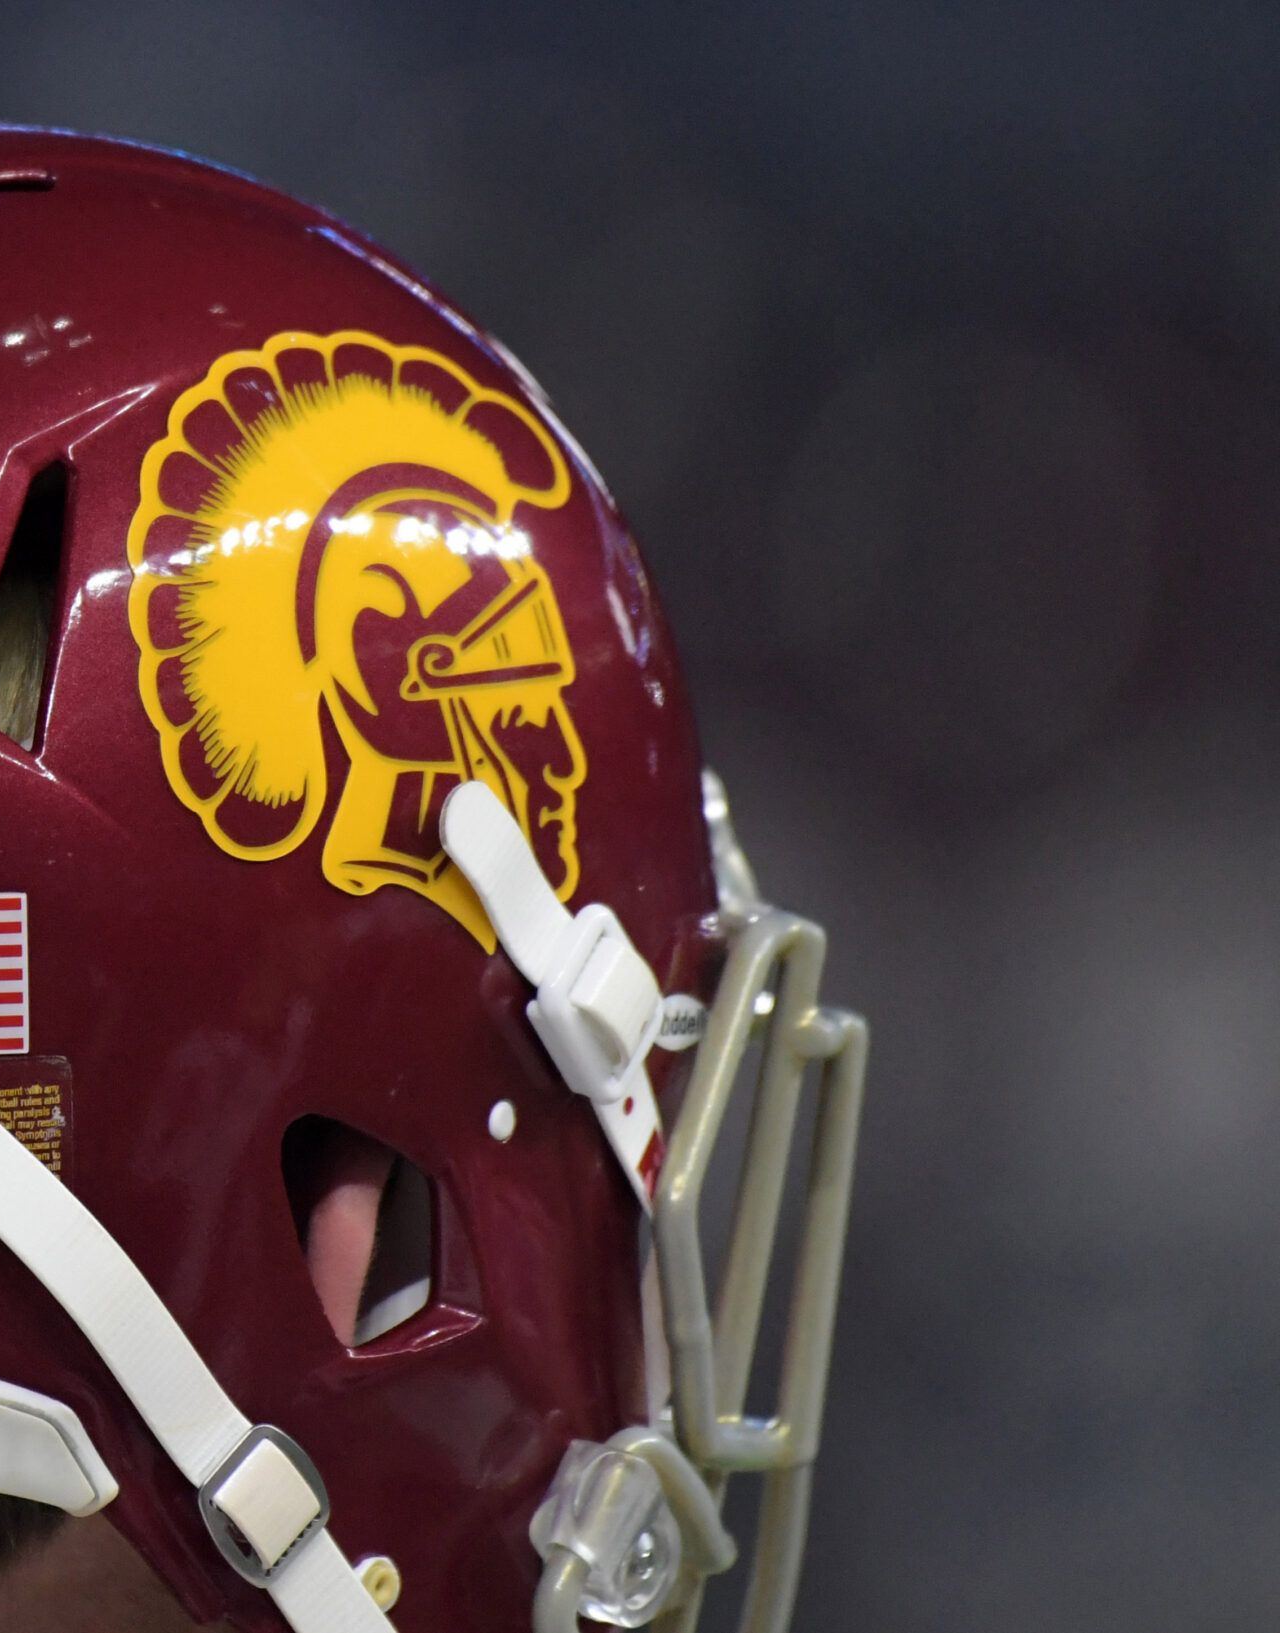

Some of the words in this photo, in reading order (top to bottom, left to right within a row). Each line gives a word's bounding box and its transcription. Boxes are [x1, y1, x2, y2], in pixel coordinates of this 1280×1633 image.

[44, 1086, 60, 1095] any
[20, 1097, 42, 1107] rules
[44, 1095, 60, 1105] and
[13, 1108, 50, 1119] paralysis
[17, 1121, 36, 1130] may
[51, 1141, 61, 1149] or
[52, 1150, 61, 1160] to
